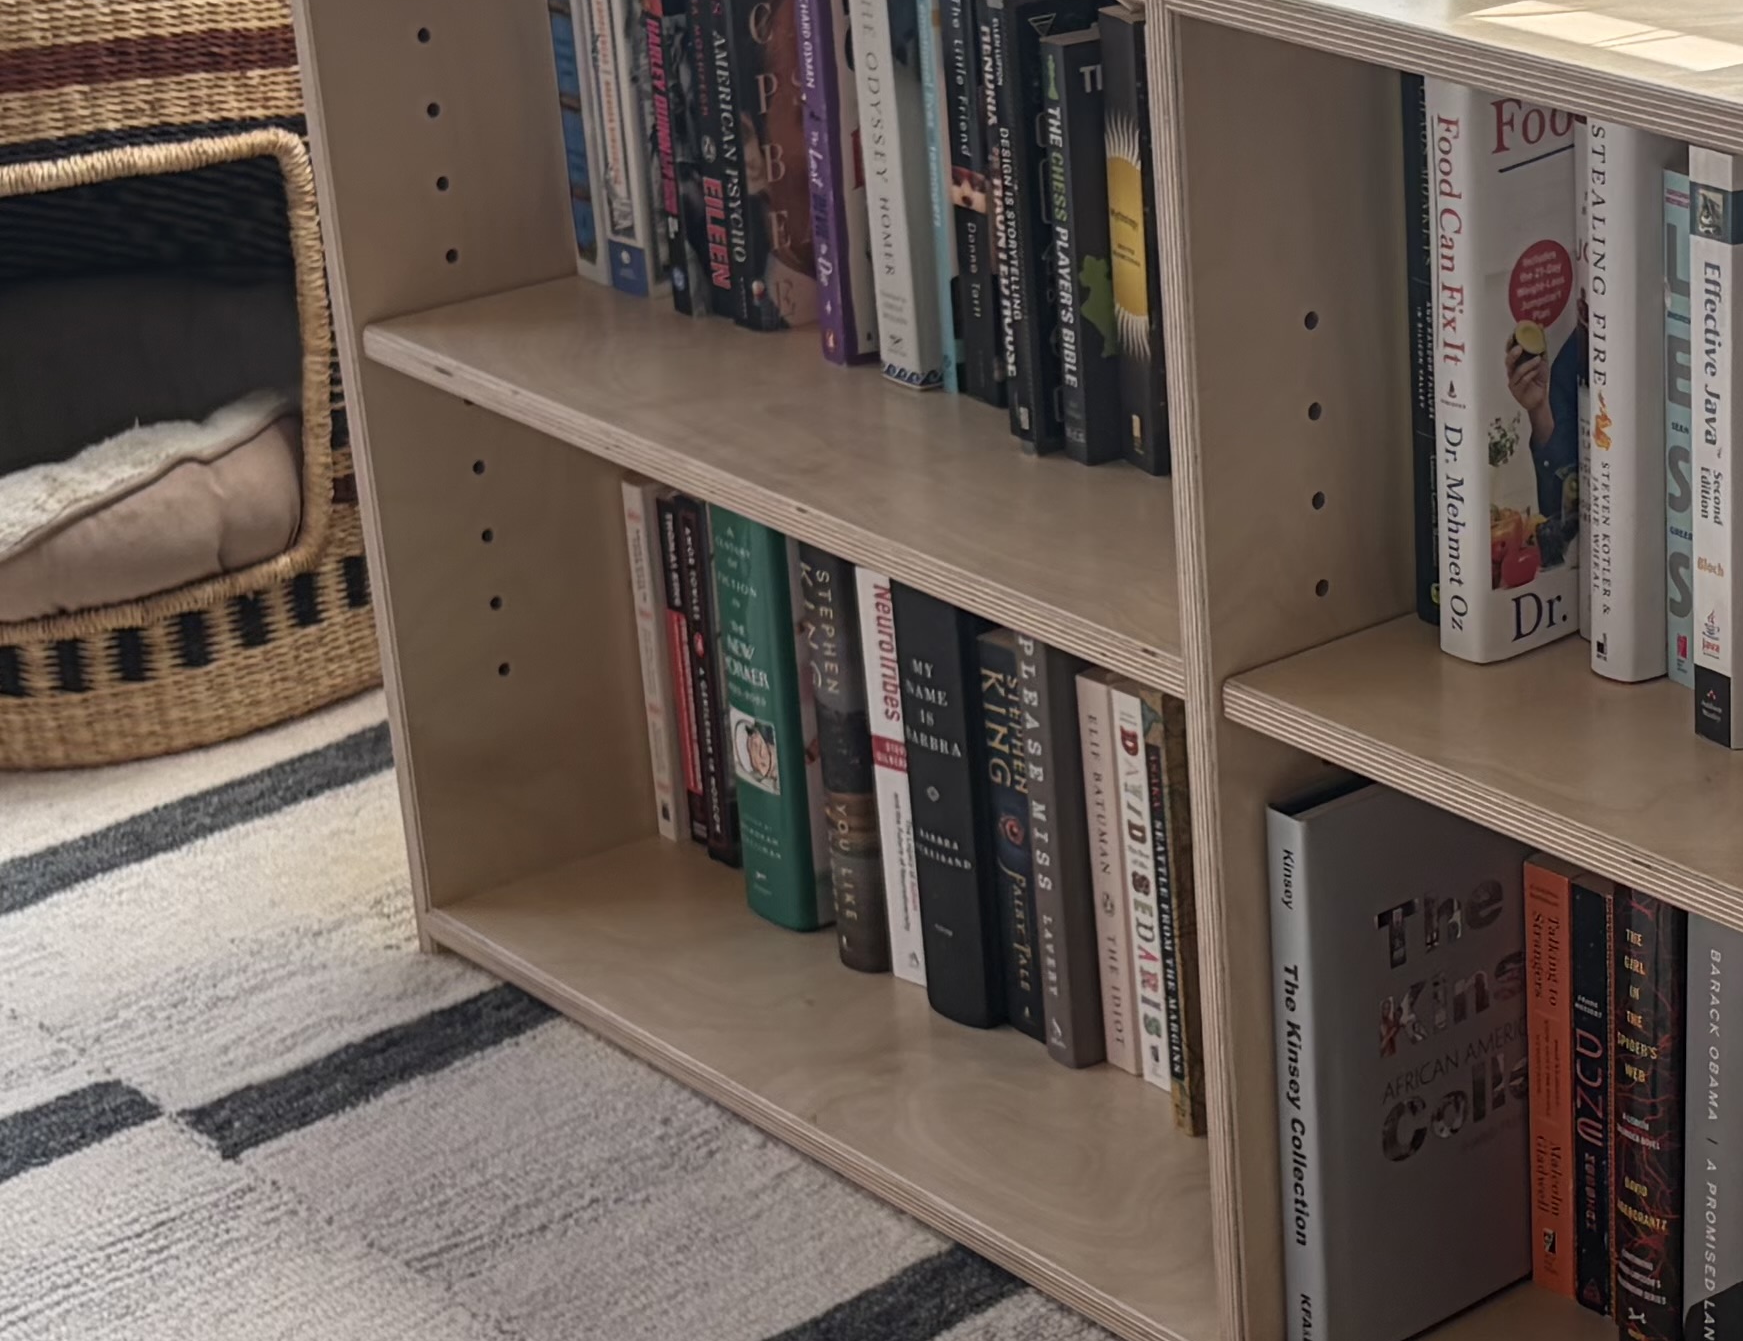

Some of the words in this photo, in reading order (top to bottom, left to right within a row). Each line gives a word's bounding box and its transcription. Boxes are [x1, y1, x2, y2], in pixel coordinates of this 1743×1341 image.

[803, 41, 816, 89] OSMAN
[954, 39, 967, 86] Little
[712, 30, 737, 162] AMERICAN
[725, 167, 746, 263] PSYCHO
[958, 96, 972, 157] Friend
[1000, 127, 1012, 187] DESIGN
[1048, 106, 1063, 148] THE
[1437, 114, 1462, 200] Food
[808, 148, 823, 188] Last
[865, 51, 888, 183] ODYSSEY
[879, 197, 895, 276] HOMER
[1052, 150, 1068, 223] CHESS
[1005, 190, 1014, 206] IS
[1591, 123, 1607, 297] STEALING
[703, 176, 731, 290] EILEEN
[967, 222, 977, 274] Donna
[1438, 208, 1463, 274] Can
[1005, 210, 1022, 321] STORYTELLING
[1054, 226, 1075, 325] PLAYER'S
[971, 283, 981, 319] Tartt
[1440, 282, 1465, 333] Fix
[1703, 260, 1722, 377] Effective
[1061, 327, 1078, 389] BIBLE
[1443, 336, 1466, 366] It
[1592, 312, 1607, 387] FIRE
[1444, 423, 1463, 465] Dr.
[1702, 384, 1722, 447] Java
[1600, 460, 1611, 526] STEVEN
[1699, 466, 1710, 520] Edition
[1711, 468, 1724, 527] Second
[685, 526, 695, 566] AMOR
[1445, 473, 1466, 590] Mehmet
[1600, 532, 1612, 598] KOTLER
[1697, 556, 1725, 578] Bloch
[815, 570, 841, 695] STEPHEN
[1450, 595, 1468, 632] Oz
[1511, 591, 1568, 642] Dr.
[904, 679, 948, 707] NAME
[912, 659, 934, 680] MY
[905, 724, 962, 758] BARBRA
[920, 709, 935, 727] IS
[980, 667, 1012, 788] KING
[1006, 674, 1029, 795] STEPHEN
[1087, 714, 1100, 757] ELIF
[836, 804, 850, 852] YOU
[1018, 633, 1044, 783] PLEASE
[1031, 799, 1052, 891] MISS
[1043, 915, 1058, 997] LAVERY
[1093, 772, 1111, 876] BATUMAN
[1281, 848, 1295, 911] Kinsey
[1130, 869, 1163, 1040] SEDARIS
[1160, 901, 1174, 951] FROM
[1372, 879, 1504, 970] The
[1532, 912, 1544, 998] Strangers
[1547, 915, 1561, 986] Talking
[1625, 928, 1643, 947] THE
[1106, 935, 1120, 976] THE
[1164, 959, 1178, 991] THE
[1623, 954, 1647, 976] GIRL
[1111, 985, 1125, 1050] IDIOT
[1284, 963, 1298, 1013] The
[1708, 948, 1721, 1040] BARACK
[1167, 996, 1183, 1074] MARGINS
[1617, 1031, 1658, 1060] SPIDER'S
[1626, 1009, 1643, 1029] THE
[1286, 1019, 1302, 1111] Kinsey
[1383, 1048, 1460, 1106] AFRICAN
[1624, 1062, 1647, 1083] WEB
[1707, 1045, 1720, 1122] OBAMA
[1290, 1116, 1308, 1249] Collection
[1536, 1134, 1551, 1214] Gladwell
[1550, 1140, 1564, 1217] Malcolm
[1706, 1159, 1717, 1172] A
[1704, 1181, 1718, 1292] PROMISED
